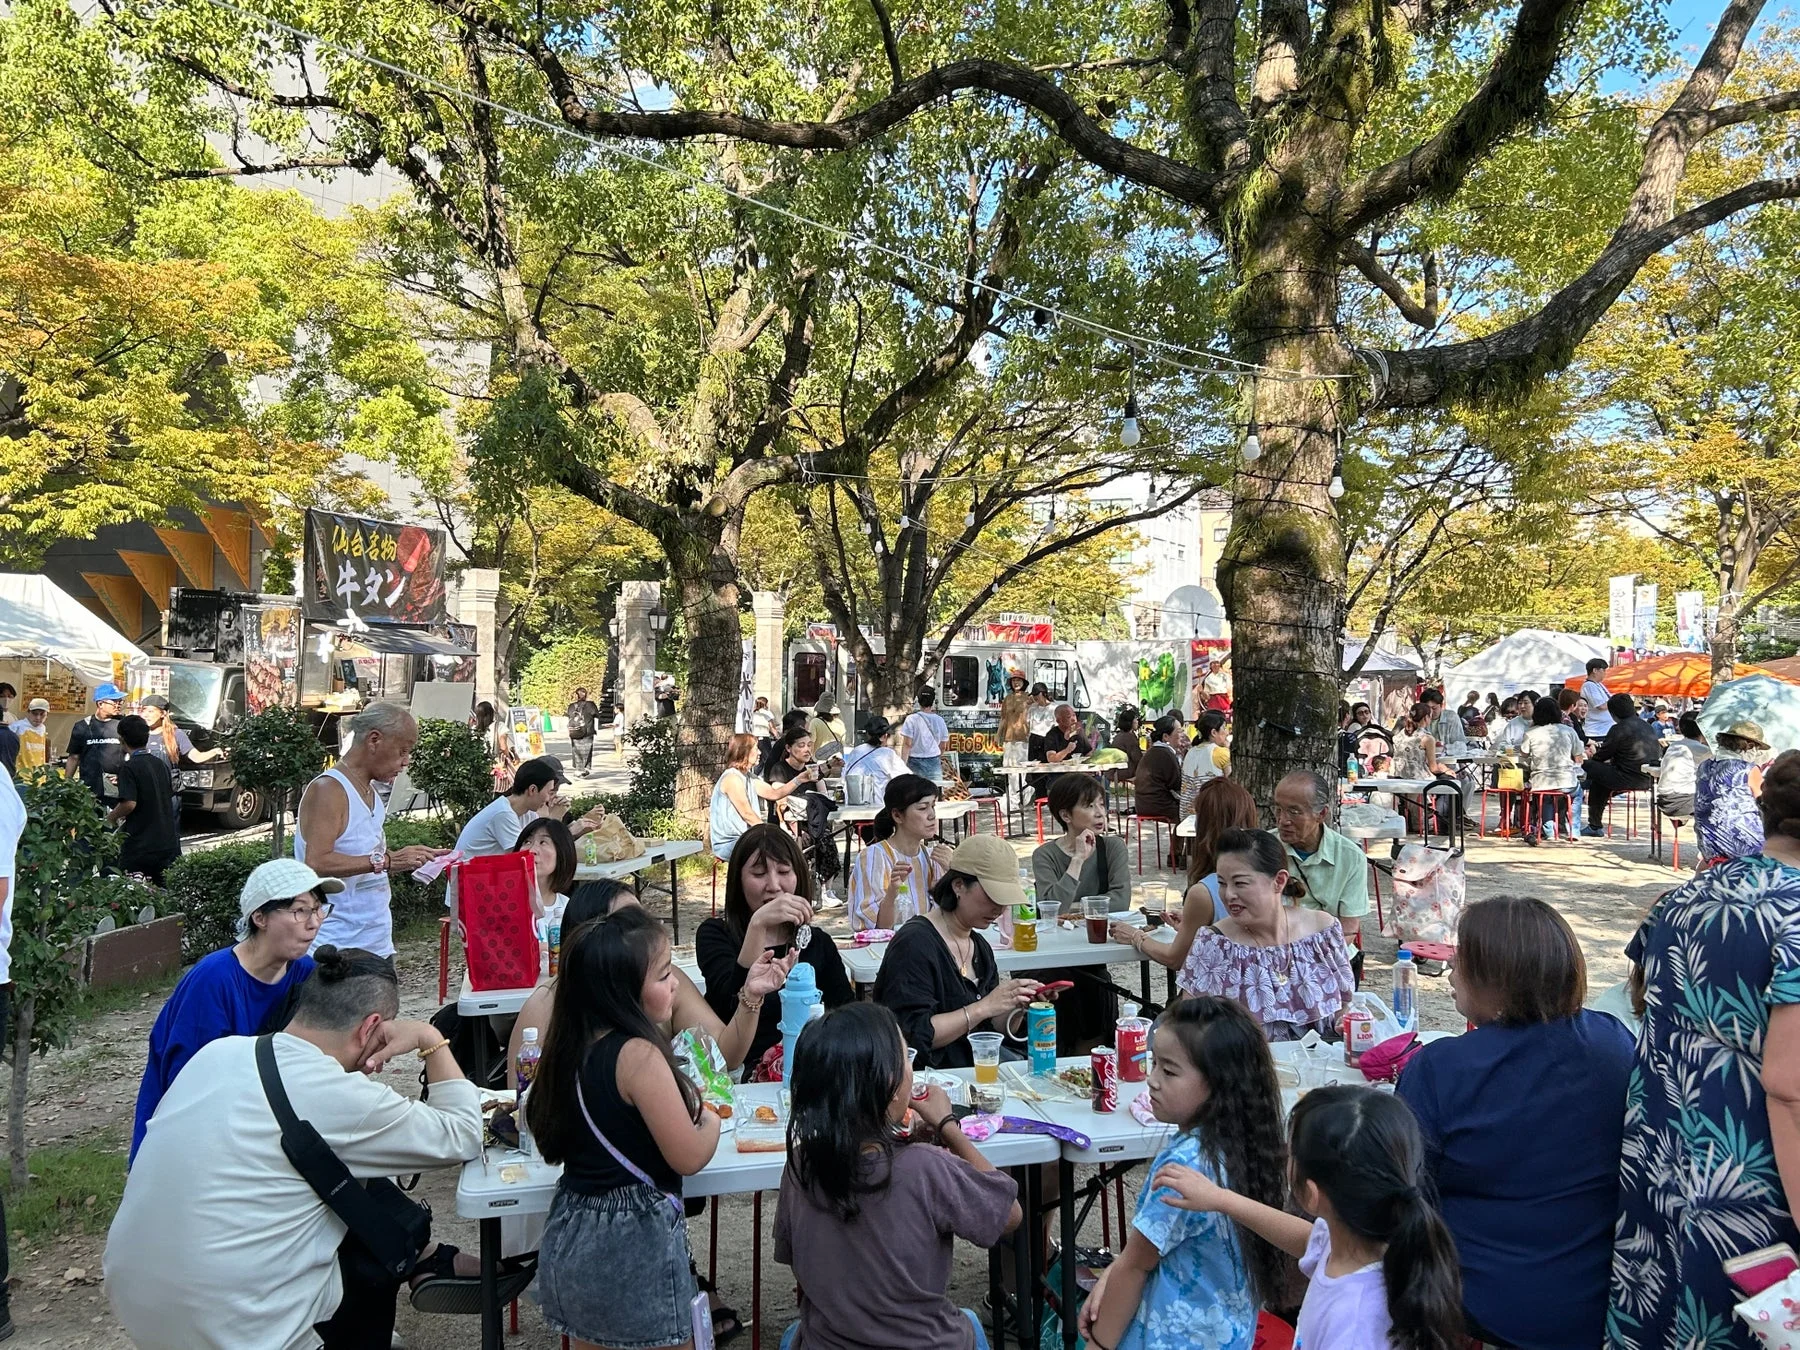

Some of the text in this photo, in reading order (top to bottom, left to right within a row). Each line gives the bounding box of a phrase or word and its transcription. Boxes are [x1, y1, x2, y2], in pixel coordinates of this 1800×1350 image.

[331, 525, 398, 562] 仙台名物
[336, 560, 406, 609] 牛タン
[945, 732, 1004, 754] EtoBUL
[1134, 1035, 1147, 1043] LIO
